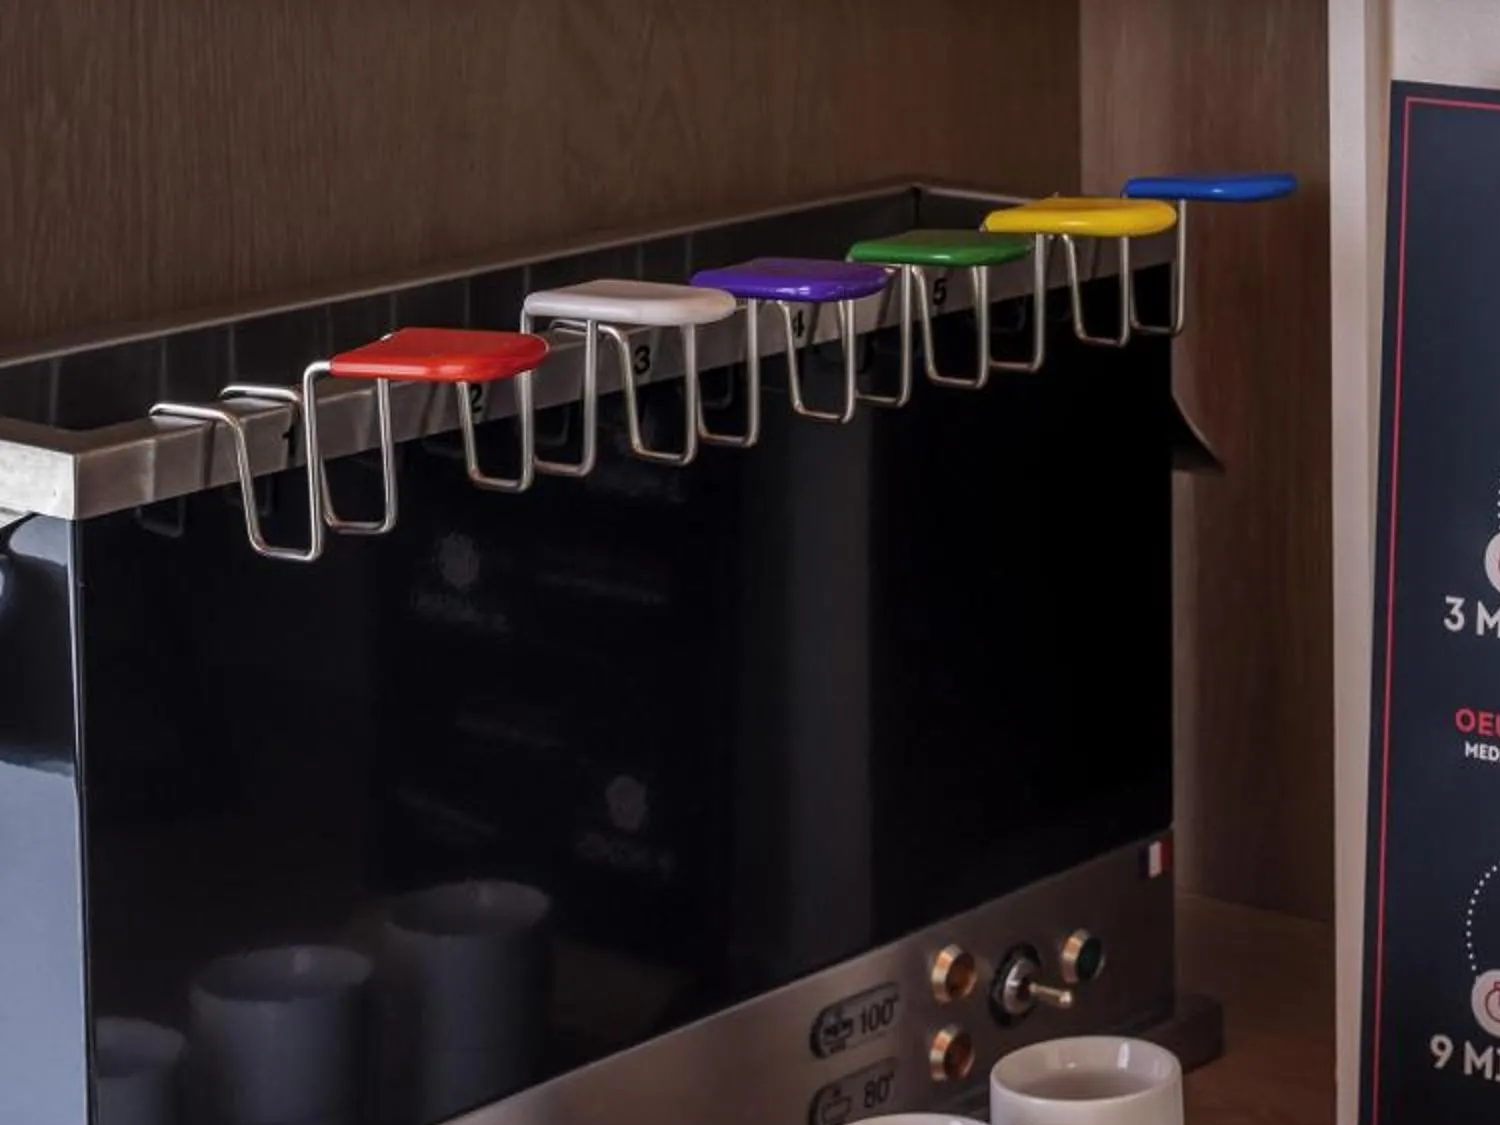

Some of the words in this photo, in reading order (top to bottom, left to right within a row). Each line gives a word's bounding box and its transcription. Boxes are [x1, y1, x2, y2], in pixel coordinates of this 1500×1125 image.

[933, 278, 947, 306] 5
[633, 345, 651, 375] 3
[470, 383, 483, 413] 2
[1444, 595, 1465, 632] 3
[1430, 1034, 1454, 1069] 9
